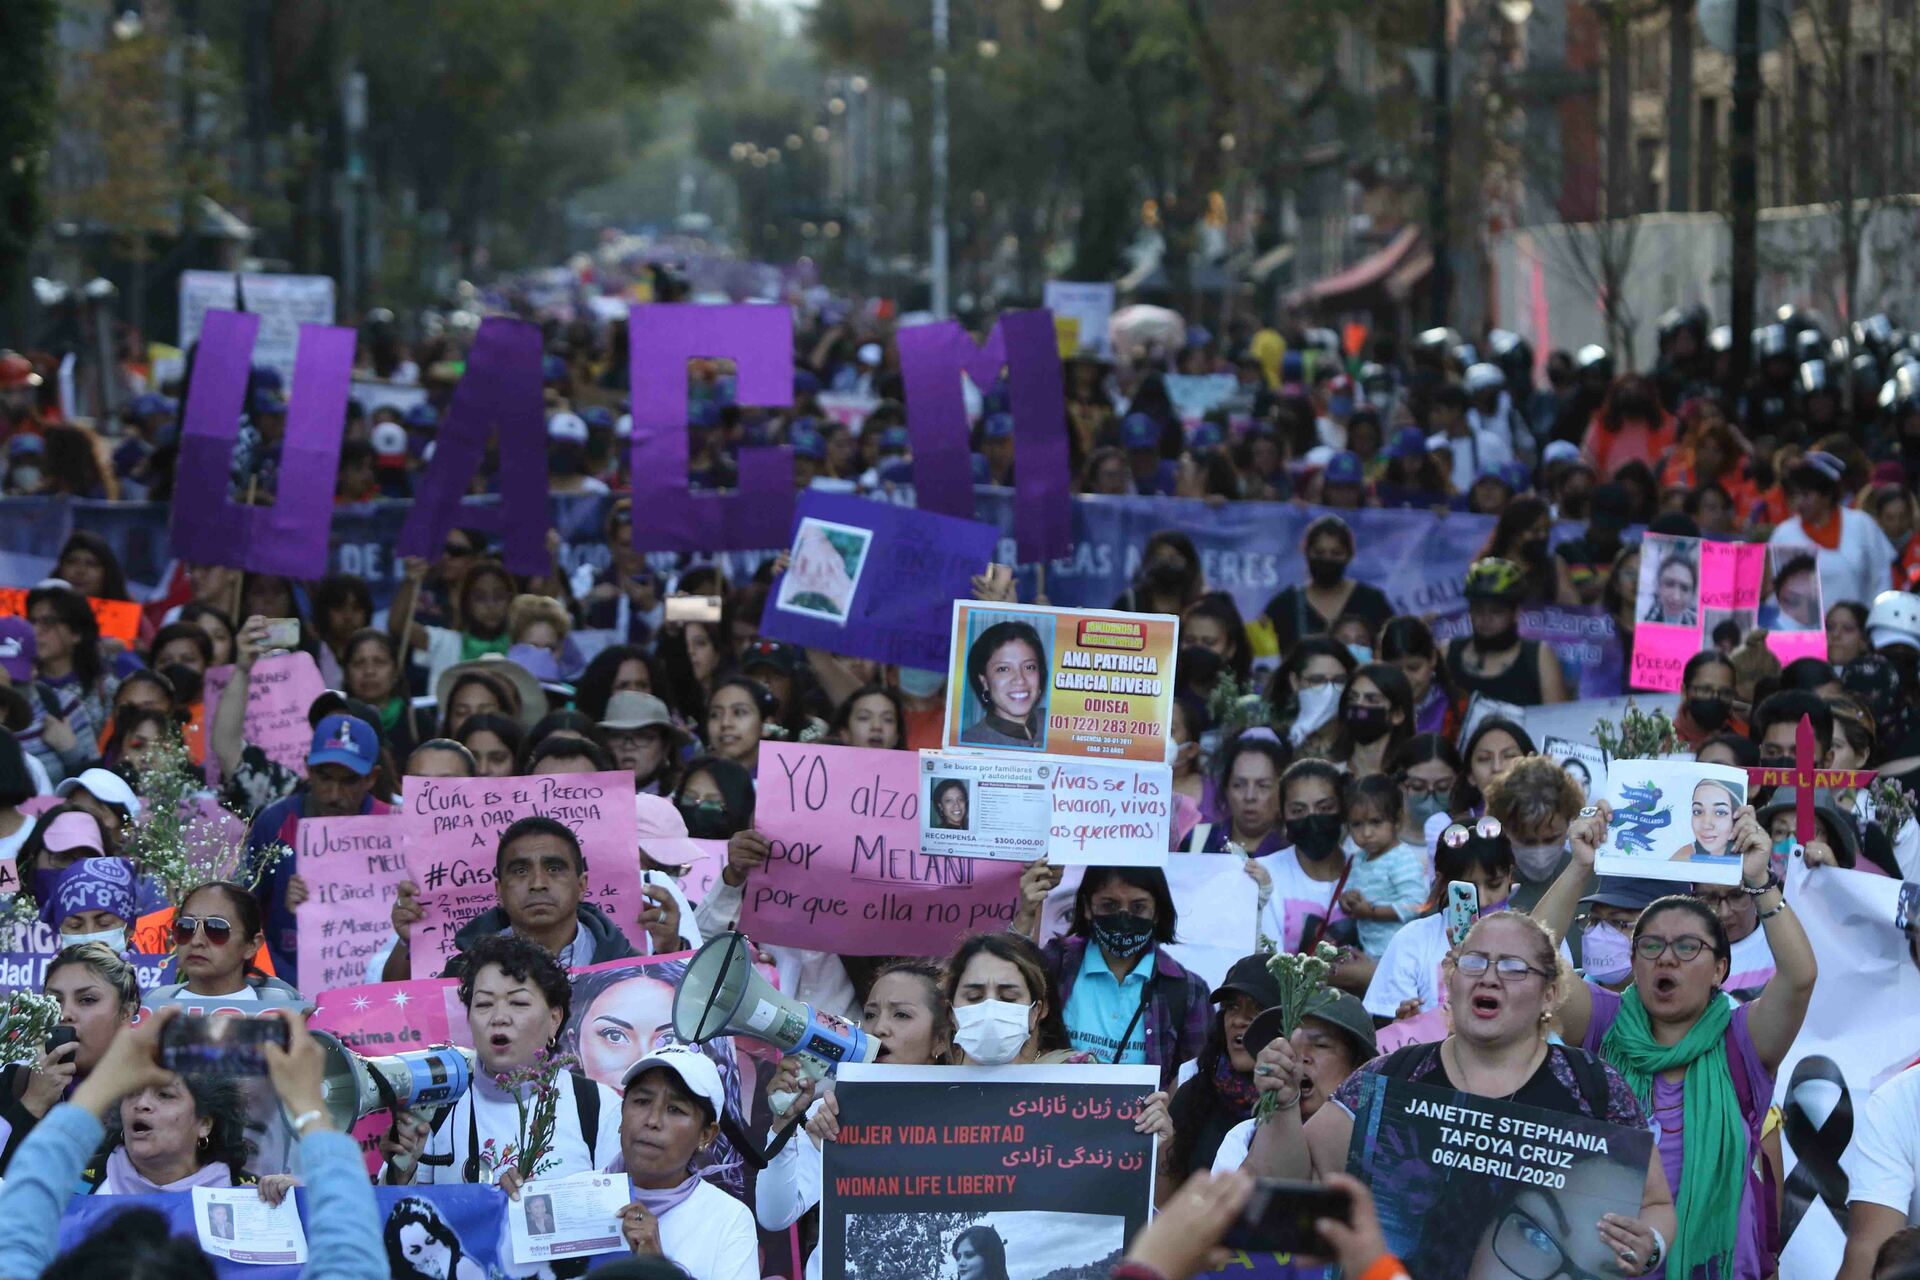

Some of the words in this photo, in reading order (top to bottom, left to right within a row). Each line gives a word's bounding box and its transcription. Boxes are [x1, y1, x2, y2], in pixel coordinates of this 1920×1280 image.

[1061, 650, 1092, 669] ANA
[1093, 653, 1159, 674] PATRICIA
[1055, 672, 1109, 692] GARCIA
[1110, 676, 1163, 697] RIVERO
[1084, 698, 1129, 714] ODISEA
[1050, 716, 1070, 730] (01
[1072, 717, 1099, 731] 722)
[1102, 719, 1127, 734] 283
[1130, 721, 1161, 737] 2012
[943, 762, 953, 771] Se
[954, 763, 978, 773] busca
[979, 765, 993, 775] por
[994, 764, 1033, 775] familiares
[987, 772, 1033, 781] autoridades
[1763, 770, 1857, 787] MELANI
[484, 791, 502, 805] ES
[512, 790, 531, 803] EL
[535, 777, 604, 802] PRECIO
[777, 753, 828, 812] YO
[851, 774, 918, 821] alzo
[1103, 779, 1127, 793] se
[1132, 772, 1160, 796] las
[1121, 796, 1167, 817] vivas
[434, 815, 474, 835] PARA
[471, 832, 486, 847] A
[925, 832, 977, 842] RECOMPENSA
[995, 837, 1045, 847] $300,000.00
[765, 839, 823, 874] por
[851, 834, 974, 885] MELANI
[438, 894, 452, 907] 2
[600, 884, 620, 896] de
[754, 886, 848, 925] porque
[863, 893, 913, 922] ella
[925, 902, 960, 923] no
[969, 900, 1019, 928] pud
[399, 1025, 421, 1042] de
[1079, 1031, 1109, 1047] PATRICIA
[1009, 1094, 1067, 1117] ئازادی
[1072, 1097, 1112, 1120] ژیان
[836, 1125, 892, 1145] MUJER
[898, 1125, 937, 1145] VIDA
[943, 1124, 1025, 1145] LIBERTAD
[1404, 1098, 1494, 1130] JANETTE
[1497, 1117, 1609, 1154] STEPHANIA
[1002, 1144, 1054, 1168] آزادی
[1057, 1146, 1113, 1168] زندگی
[1439, 1126, 1514, 1157] TAFOYA
[1519, 1144, 1574, 1169] CRUZ
[1118, 1151, 1143, 1170] زن
[1431, 1148, 1566, 1190] 06/ABRIL/2020
[836, 1176, 900, 1196] WOMAN
[904, 1175, 941, 1195] LIFE
[946, 1174, 1018, 1195] LIBERTY
